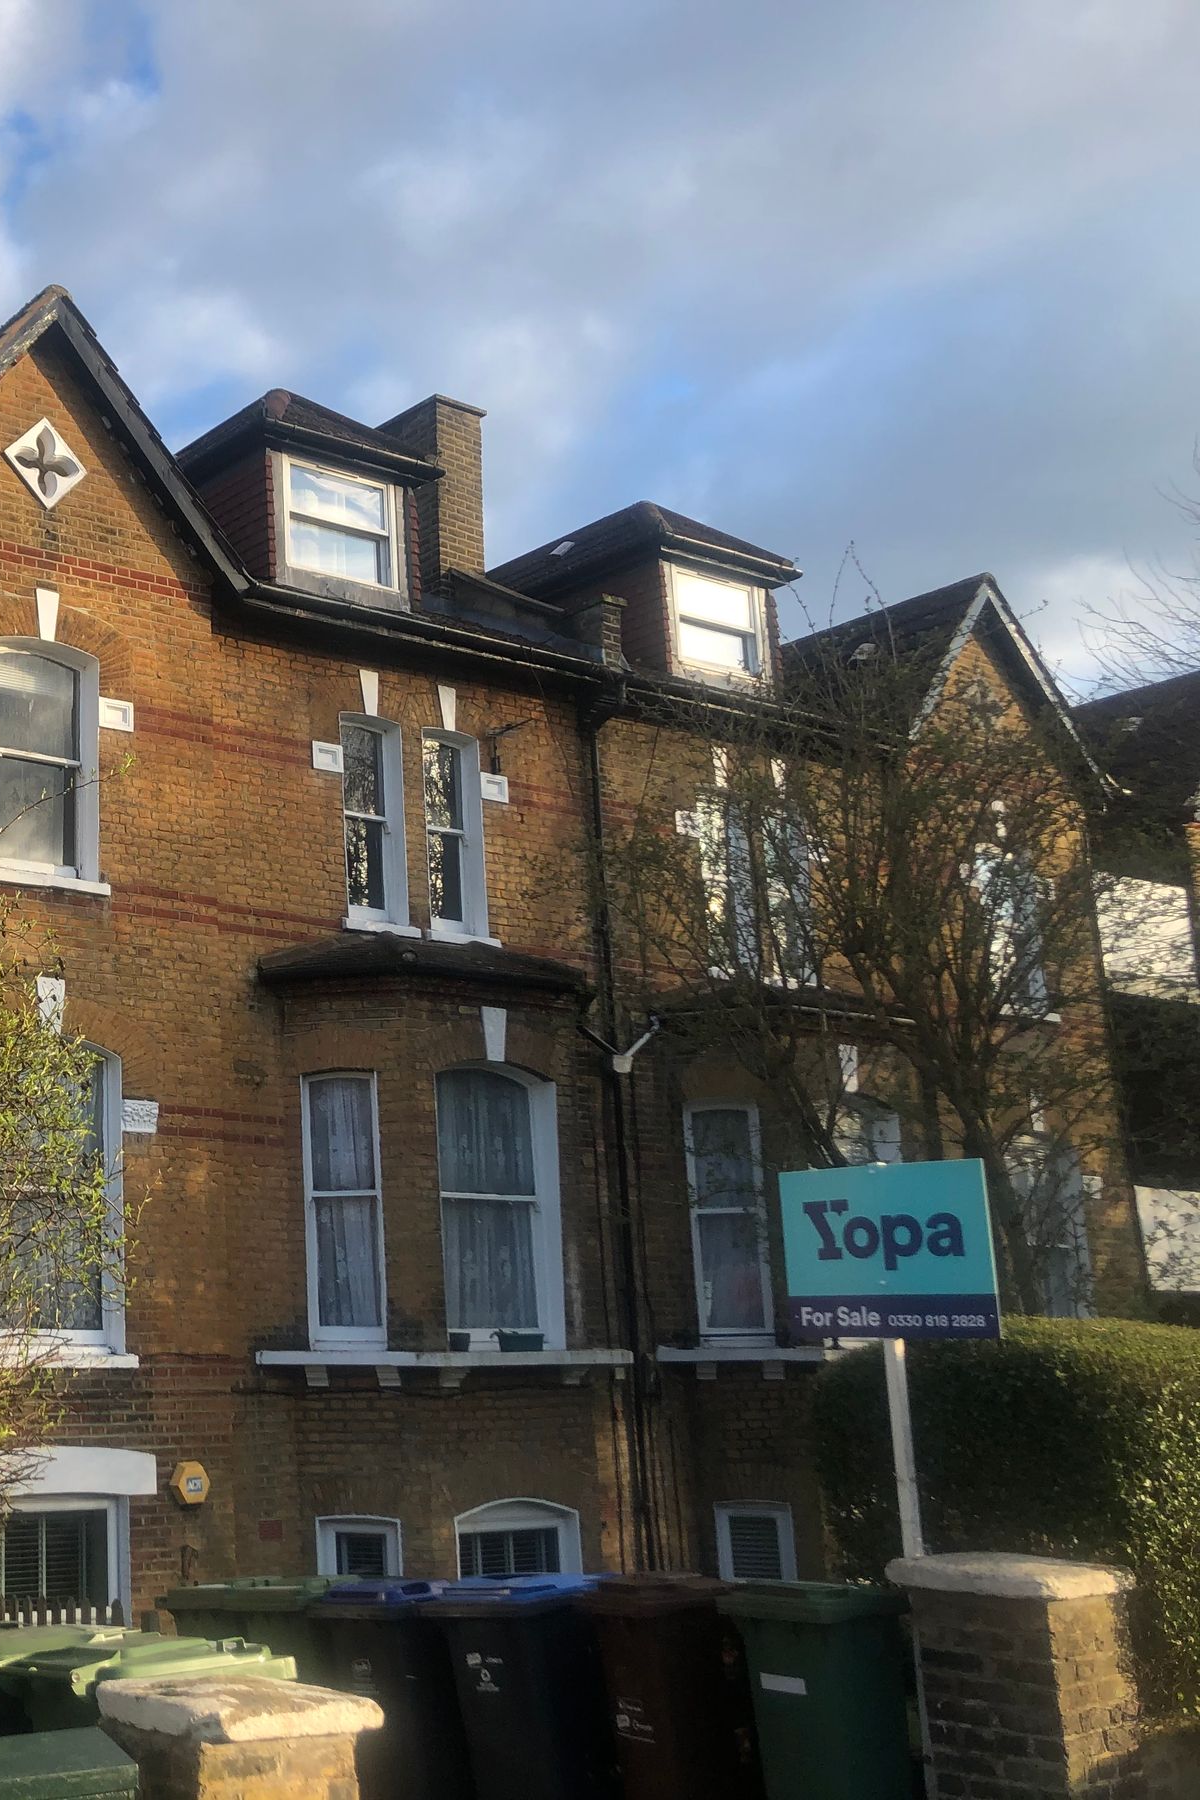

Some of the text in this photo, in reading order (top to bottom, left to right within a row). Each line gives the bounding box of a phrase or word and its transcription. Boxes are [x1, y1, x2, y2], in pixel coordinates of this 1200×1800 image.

[802, 1199, 966, 1271] Yopa
[800, 1306, 834, 1327] For
[837, 1306, 881, 1327] Sale
[888, 1315, 922, 1327] 0330
